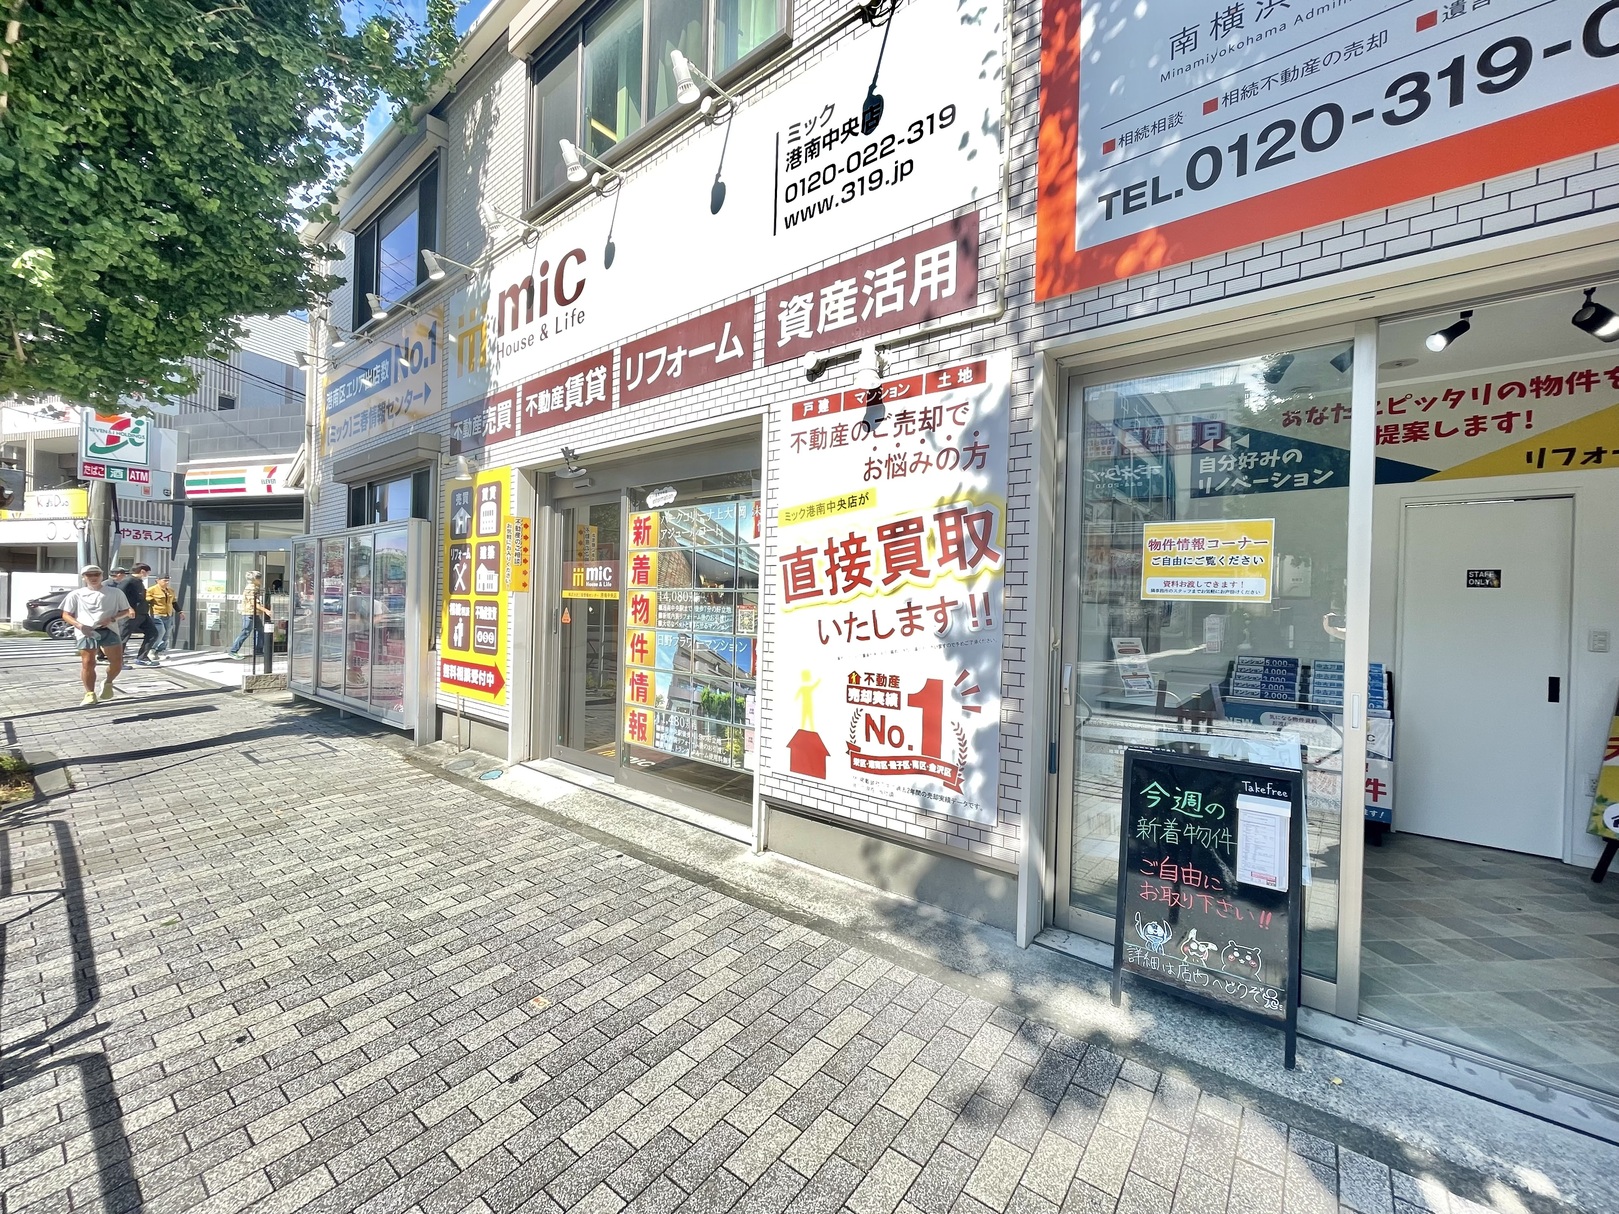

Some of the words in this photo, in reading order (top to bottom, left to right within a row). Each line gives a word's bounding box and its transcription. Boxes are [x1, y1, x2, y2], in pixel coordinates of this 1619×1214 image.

[1160, 21, 1287, 83] Minamiyokohama
[1221, 29, 1389, 108] 相続不動産の売却
[785, 103, 881, 172] 港南中央店
[787, 103, 836, 144] ミック
[1118, 110, 1184, 148] 相続相談
[784, 103, 957, 204] 0120-022-319
[784, 159, 914, 230] www.319.jp
[776, 240, 959, 348] 資産活用
[393, 320, 438, 385] No.1
[495, 333, 535, 363] House
[538, 323, 549, 342] &
[555, 308, 586, 334] Life
[625, 321, 745, 392] リフォーム
[525, 365, 608, 418] 不動産賃貸
[802, 399, 830, 417] 戸建
[854, 384, 911, 404] マンション
[937, 367, 974, 389] 土地
[453, 399, 513, 441] 不動産売買
[790, 401, 970, 454] 不動産のご売却で
[83, 465, 105, 477] たばこ
[110, 468, 124, 479] 酒
[130, 471, 149, 482] ATM
[863, 441, 990, 482] お悩みの方
[1198, 469, 1334, 494] リノベーション
[1199, 448, 1303, 474] 自分好みの
[785, 492, 870, 522] ミック港南中央店が
[451, 546, 471, 561] リフォーム
[779, 507, 1001, 604] 直接買取
[1148, 536, 1269, 551] 物件情報コーナー
[1151, 555, 1264, 566] ご自由にご覧ください
[864, 672, 901, 689] 不動産
[1140, 780, 1225, 820] 今週の
[1136, 815, 1238, 855] 新着物件
[1140, 856, 1224, 892] ご自由に
